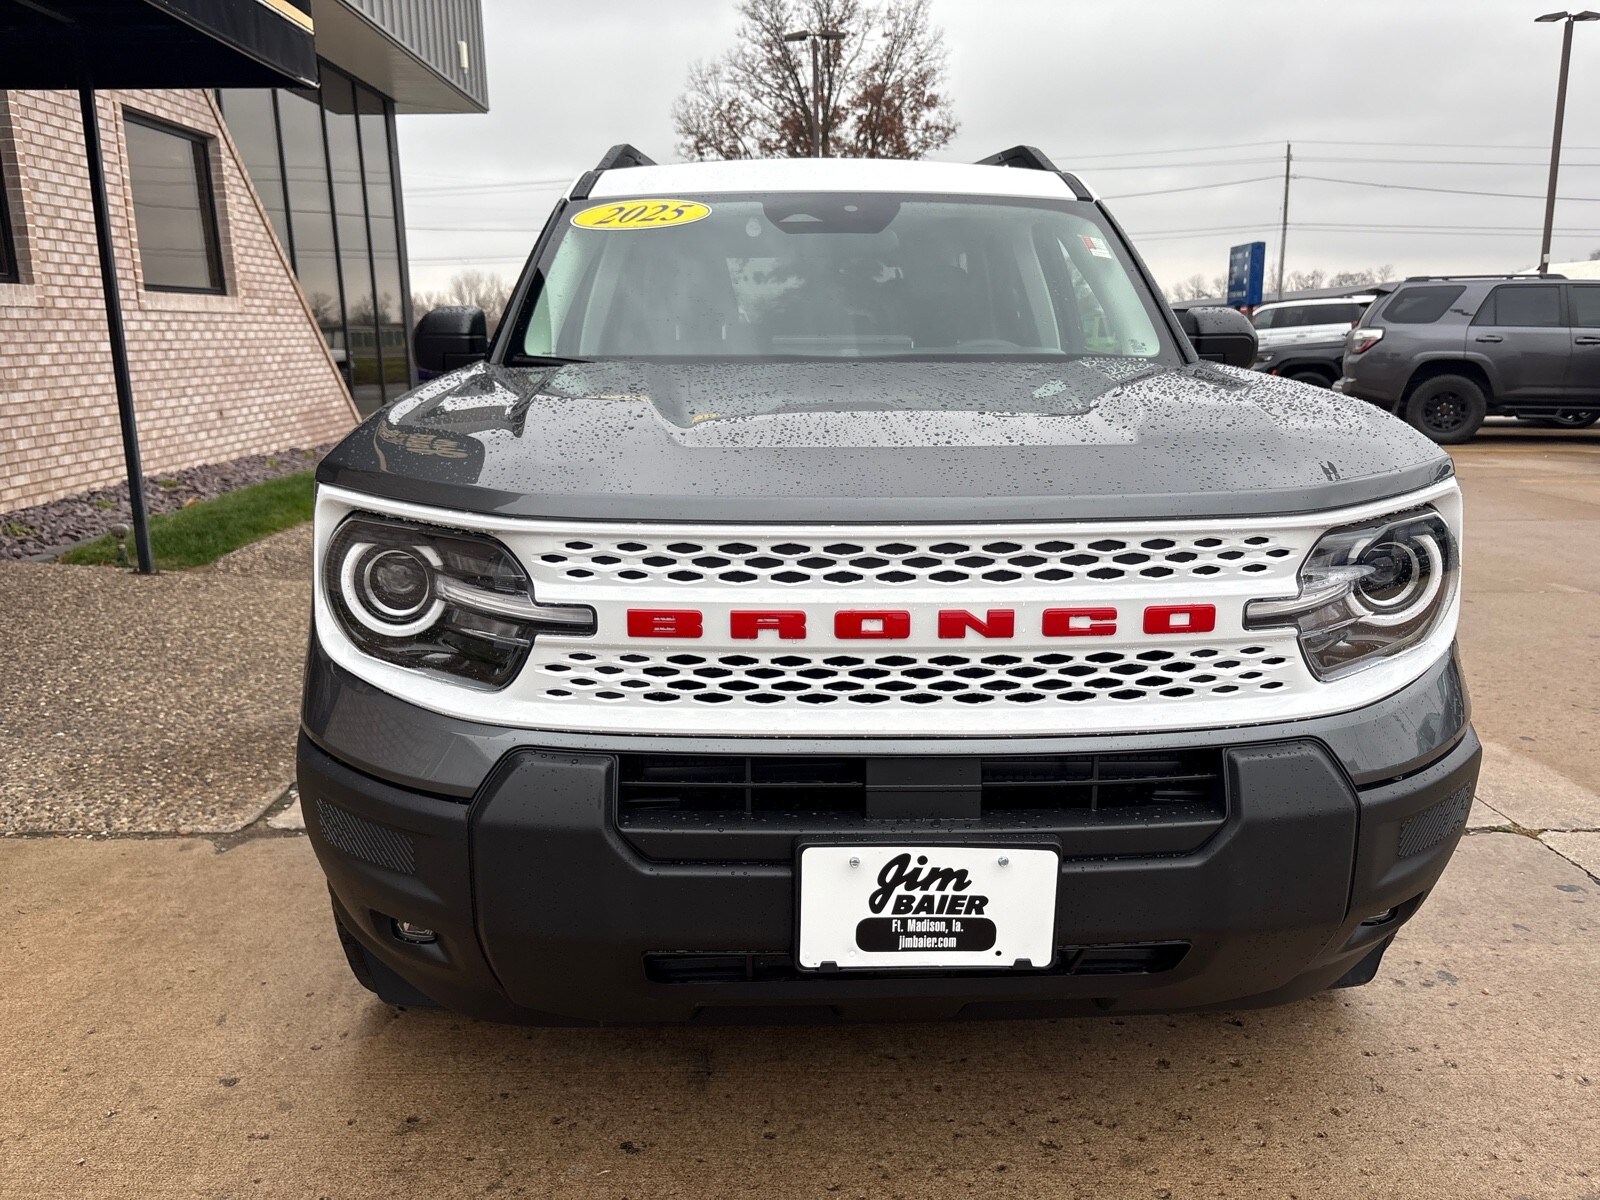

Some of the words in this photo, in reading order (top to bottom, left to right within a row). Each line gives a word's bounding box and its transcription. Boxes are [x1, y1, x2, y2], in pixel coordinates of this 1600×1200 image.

[593, 204, 694, 225] 2025
[627, 604, 1216, 639] BRONCO
[869, 853, 972, 914] Jim
[891, 895, 988, 915] BAIER
[892, 919, 904, 932] Ft.
[907, 919, 949, 934] Madison,
[898, 935, 957, 950] jimbaier.com
